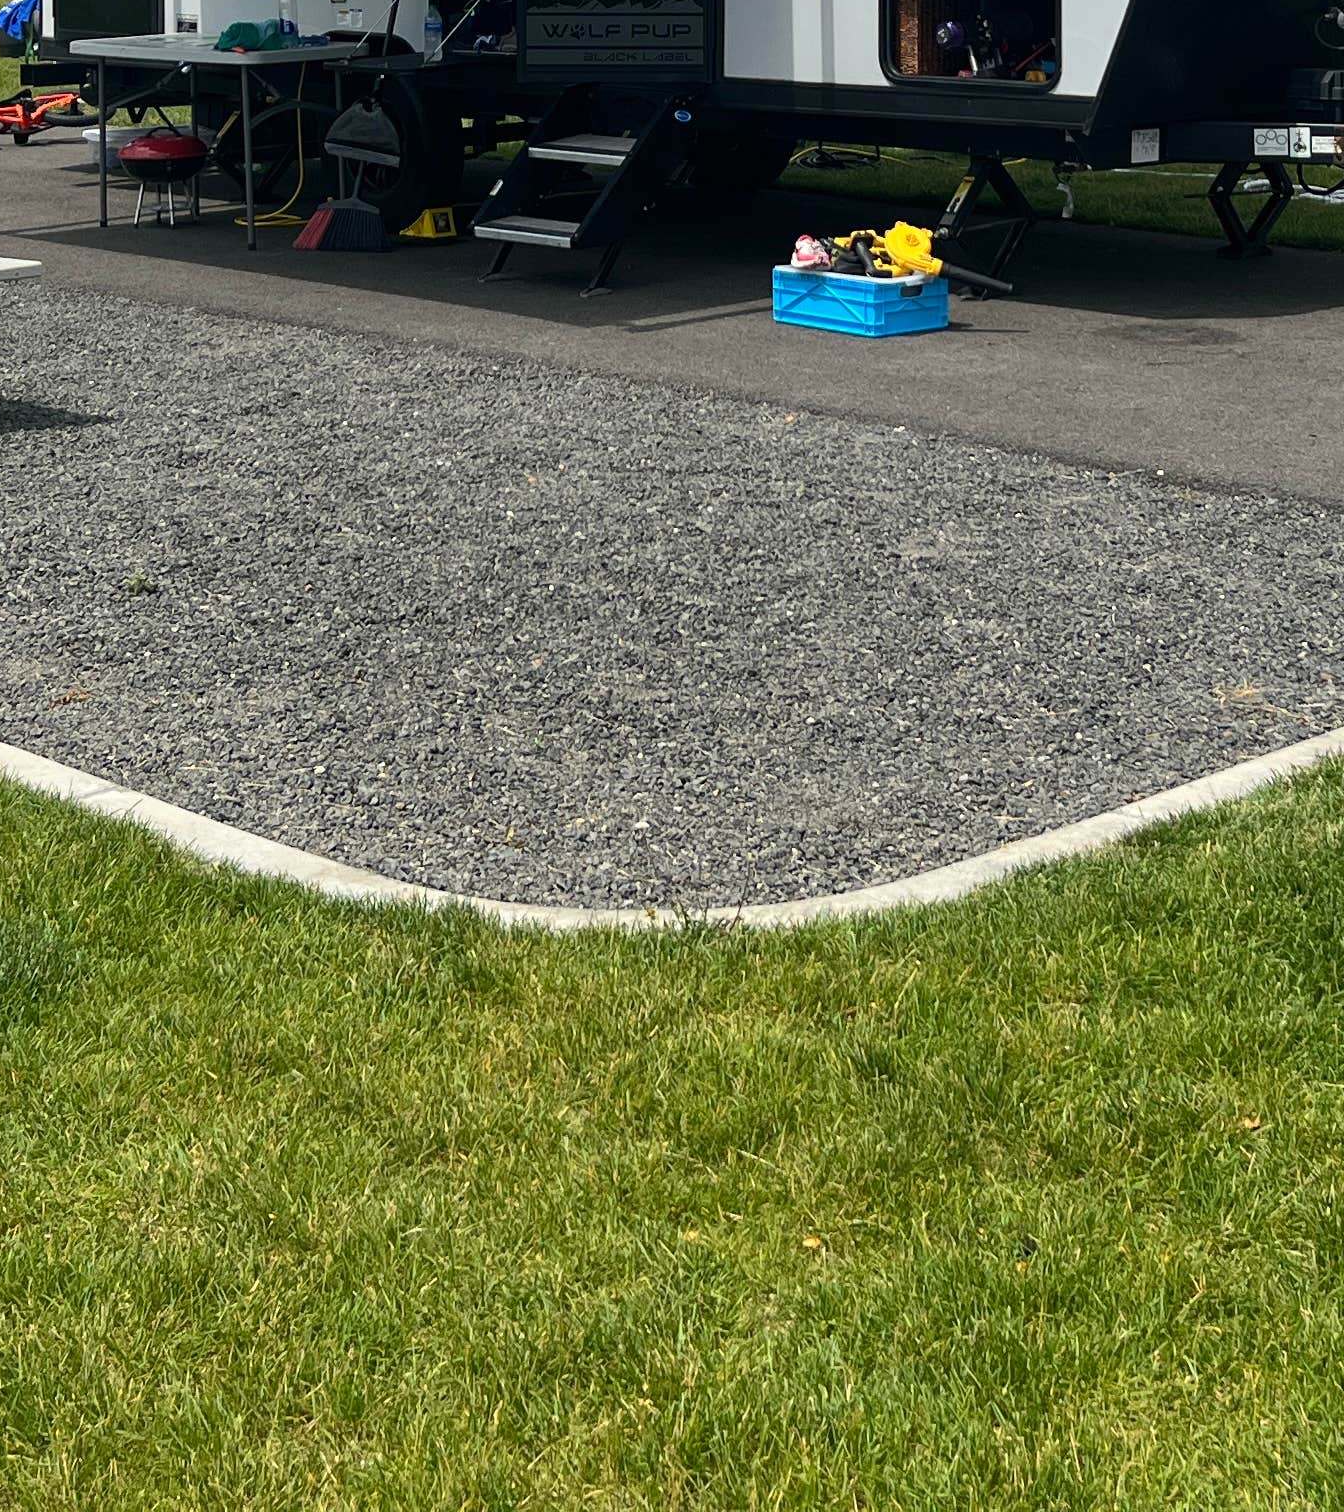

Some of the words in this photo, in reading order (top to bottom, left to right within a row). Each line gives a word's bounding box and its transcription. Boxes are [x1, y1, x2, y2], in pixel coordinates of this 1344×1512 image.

[631, 23, 691, 38] PUP
[584, 52, 637, 62] BLACK
[643, 52, 694, 62] LABEL
